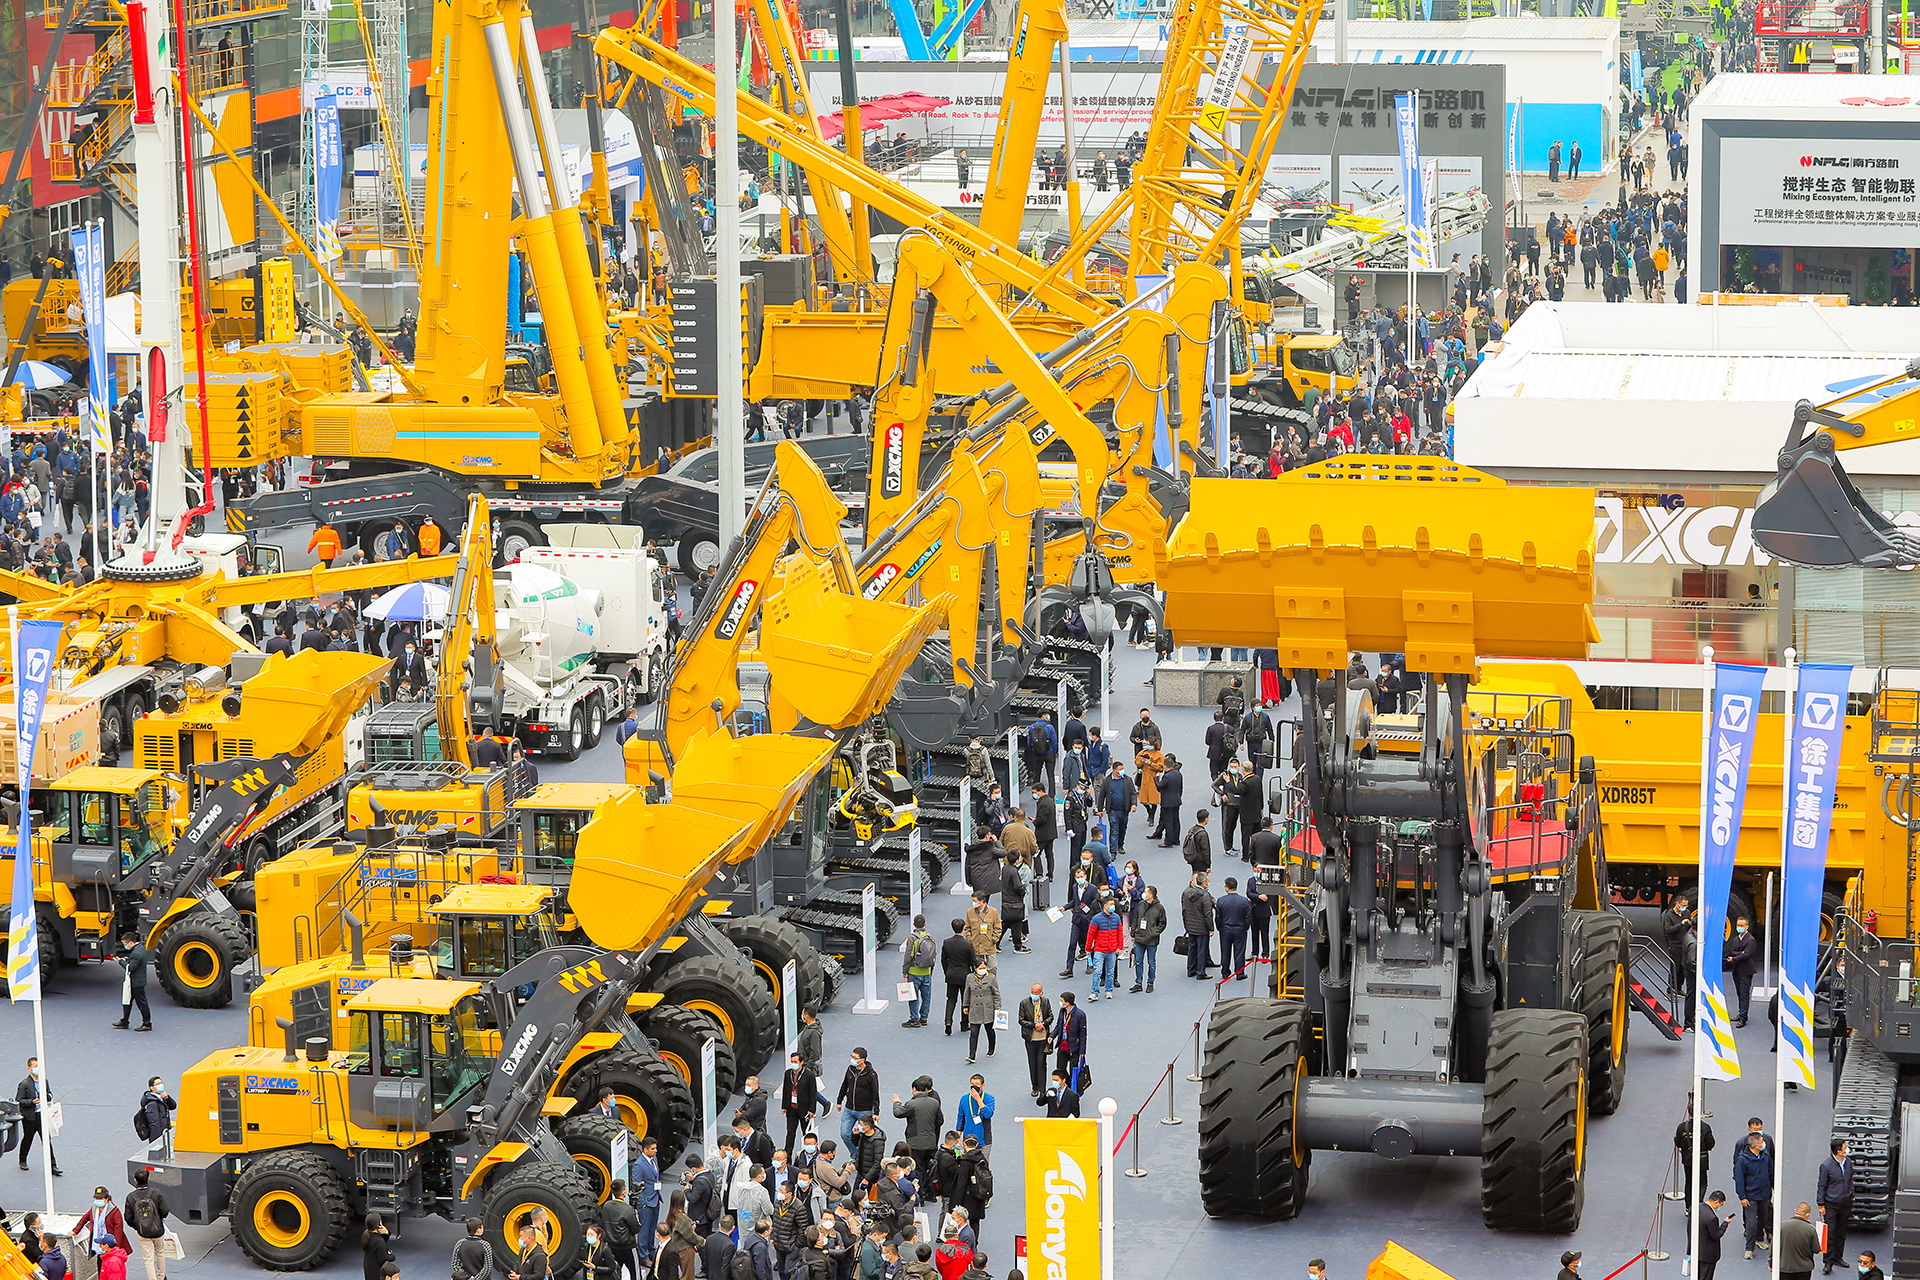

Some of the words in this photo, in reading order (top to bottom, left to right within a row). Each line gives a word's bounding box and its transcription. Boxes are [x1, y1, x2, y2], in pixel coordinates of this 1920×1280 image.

[1239, 38, 1250, 55] BOOM
[1211, 37, 1241, 104] 起重臂下严禁站人
[1233, 53, 1244, 72] UNDER
[1229, 70, 1239, 89] STAND
[670, 83, 694, 100] XCMG
[1291, 87, 1375, 110] NFLG
[955, 96, 1003, 107] 从砂石到建
[1220, 98, 1228, 107] DO
[1423, 113, 1486, 130] 断创新
[1812, 157, 1850, 168] NFLG
[1852, 158, 1900, 169] 南方路机
[1783, 176, 1846, 193] 搅拌生态
[1851, 177, 1915, 194] 智能物联
[1027, 194, 1062, 206] 方路机
[1783, 193, 1811, 203] Mixing
[1812, 194, 1859, 203] Ecosystem,
[1860, 194, 1901, 204] Intelligent
[923, 222, 977, 259] XGC11000A
[889, 426, 903, 478] XCMG
[728, 582, 756, 626] XCMG
[1601, 786, 1657, 805] XDR85T
[1711, 730, 1742, 847] XCMG
[1792, 736, 1829, 850] 徐工集团
[197, 803, 223, 835] XCMG
[375, 867, 418, 880] XCMG
[508, 1023, 539, 1066] XCMG
[260, 1077, 299, 1089] XCMG
